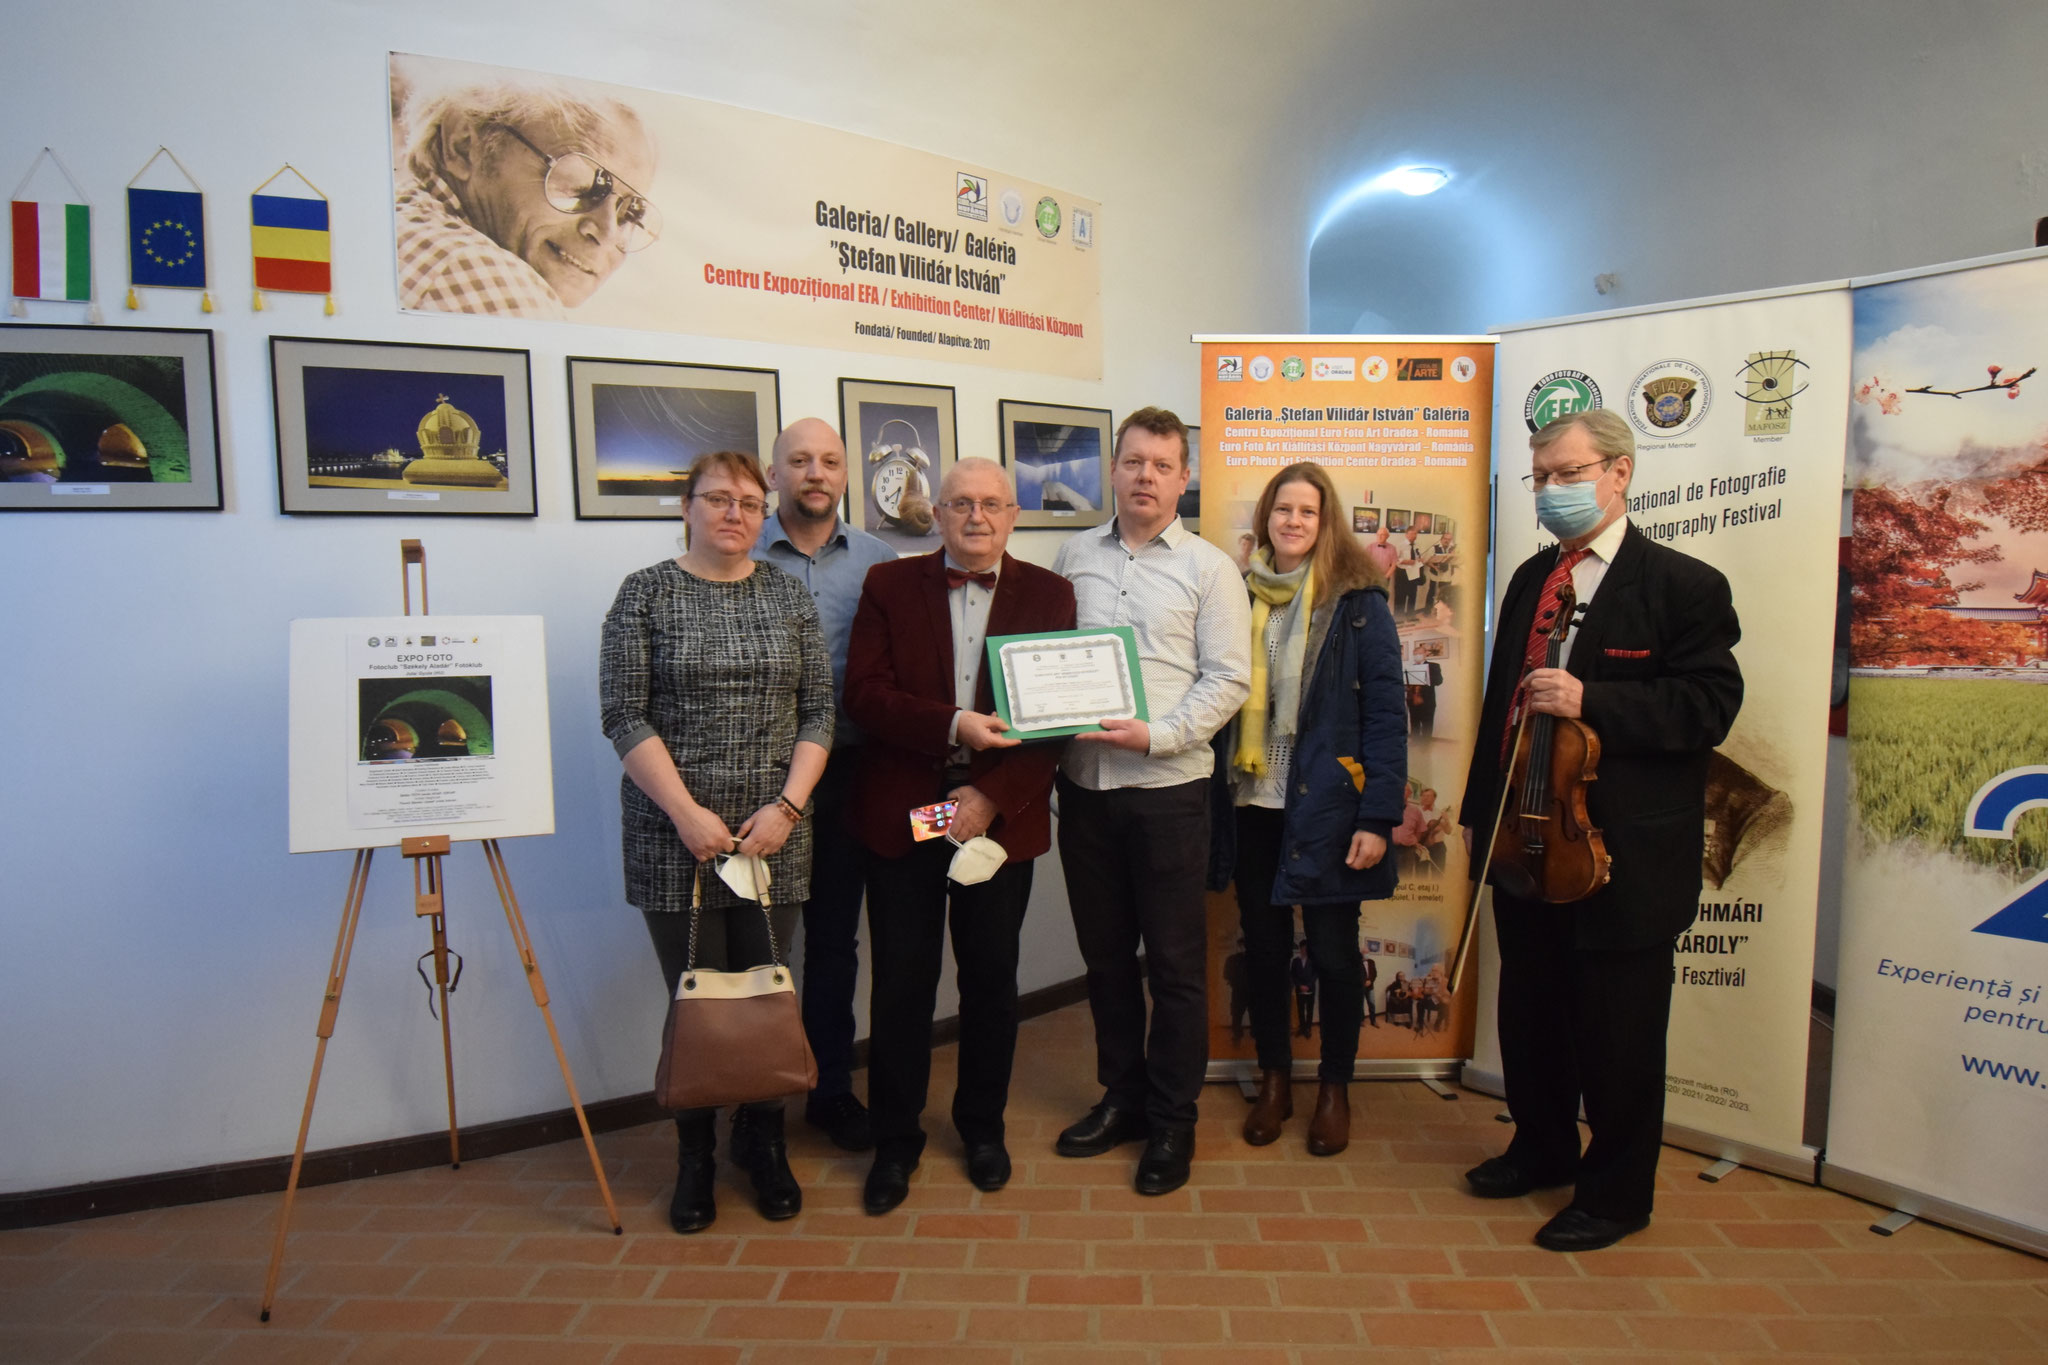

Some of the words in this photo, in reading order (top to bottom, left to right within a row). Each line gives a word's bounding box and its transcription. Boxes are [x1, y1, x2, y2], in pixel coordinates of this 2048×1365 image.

[815, 200, 890, 238] Galeria/
[895, 216, 959, 254] Gallery/
[965, 231, 1016, 265] Galéria
[900, 252, 952, 282] Vilidár
[703, 263, 760, 290] Centru
[763, 270, 854, 303] Expozițional
[858, 286, 880, 305] EFA
[890, 289, 951, 316] Exhibition
[953, 299, 996, 323] Center/
[1046, 315, 1083, 338] Központ
[897, 327, 937, 343] Founded/
[973, 337, 990, 351] 2017
[1414, 368, 1438, 378] ARTE
[1584, 378, 1602, 410] Associatio
[1631, 362, 1671, 397] INTERNATIONALE
[1687, 378, 1709, 427] PHOTOGRAPHIQUE
[1651, 380, 1690, 396] FIAP
[1225, 407, 1272, 421] Galeria
[1326, 406, 1370, 421] Vilidár
[1423, 406, 1470, 421] Galéria
[1225, 427, 1258, 438] Centru
[1320, 427, 1342, 438] Euro
[1344, 427, 1364, 438] Foto
[1366, 427, 1380, 438] Art
[1383, 427, 1419, 438] Oradea
[1426, 427, 1469, 438] Romania
[1748, 422, 1787, 432] MAFOSZ
[1219, 441, 1242, 452] Euro
[1243, 441, 1264, 452] Foto
[1265, 441, 1280, 452] Art
[1637, 443, 1666, 452] Regional
[1668, 441, 1697, 450] Member
[1753, 435, 1783, 443] Member
[1226, 455, 1248, 466] Euro
[1249, 455, 1278, 466] Photo
[1280, 455, 1294, 466] Art
[1346, 455, 1379, 466] Center
[1381, 455, 1417, 467] Oradea
[1424, 455, 1467, 466] Romania
[1626, 485, 1681, 515] național
[1686, 483, 1704, 503] de
[1710, 466, 1786, 500] Fotografie
[1637, 511, 1718, 541] hotography
[1722, 499, 1782, 528] Festival
[396, 654, 424, 662] EXPO
[426, 654, 453, 662] FOTO
[1699, 897, 1763, 923] HMÁRI
[1682, 966, 1745, 987] Fesztivál
[1877, 957, 2014, 1000] Experiență
[2018, 984, 2042, 1006] și
[1696, 1081, 1719, 1092] márka
[1720, 1086, 1739, 1099] (RO)
[1705, 1093, 1728, 1106] 2022/
